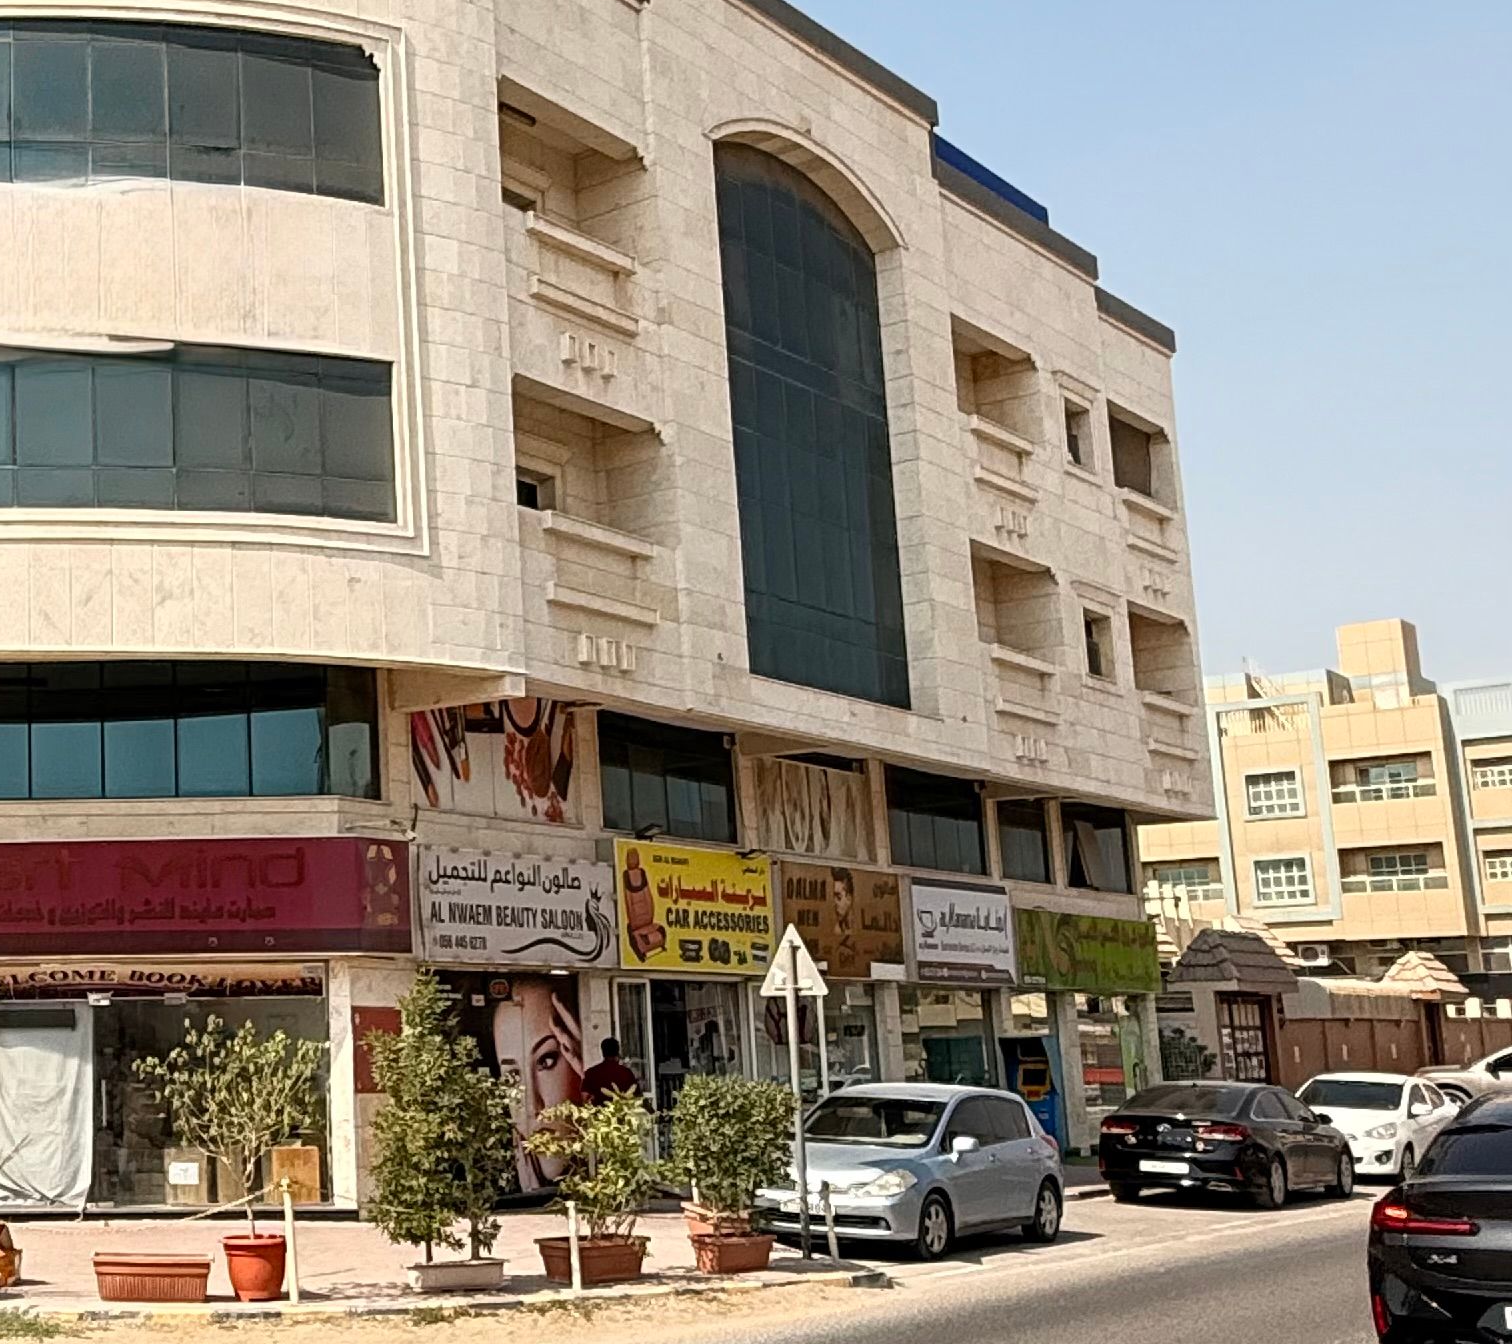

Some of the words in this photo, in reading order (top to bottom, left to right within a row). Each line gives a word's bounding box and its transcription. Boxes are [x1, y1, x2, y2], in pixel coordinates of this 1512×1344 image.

[428, 855, 488, 887] للتجميل
[490, 862, 541, 893] النواعم
[542, 866, 582, 895] صالون
[431, 901, 445, 924] AL
[496, 904, 538, 929] BEAUTY
[541, 908, 584, 932] SALOON
[666, 907, 690, 930] CAR
[693, 910, 770, 935] ACCESSORIES
[129, 969, 206, 989] BOOK
